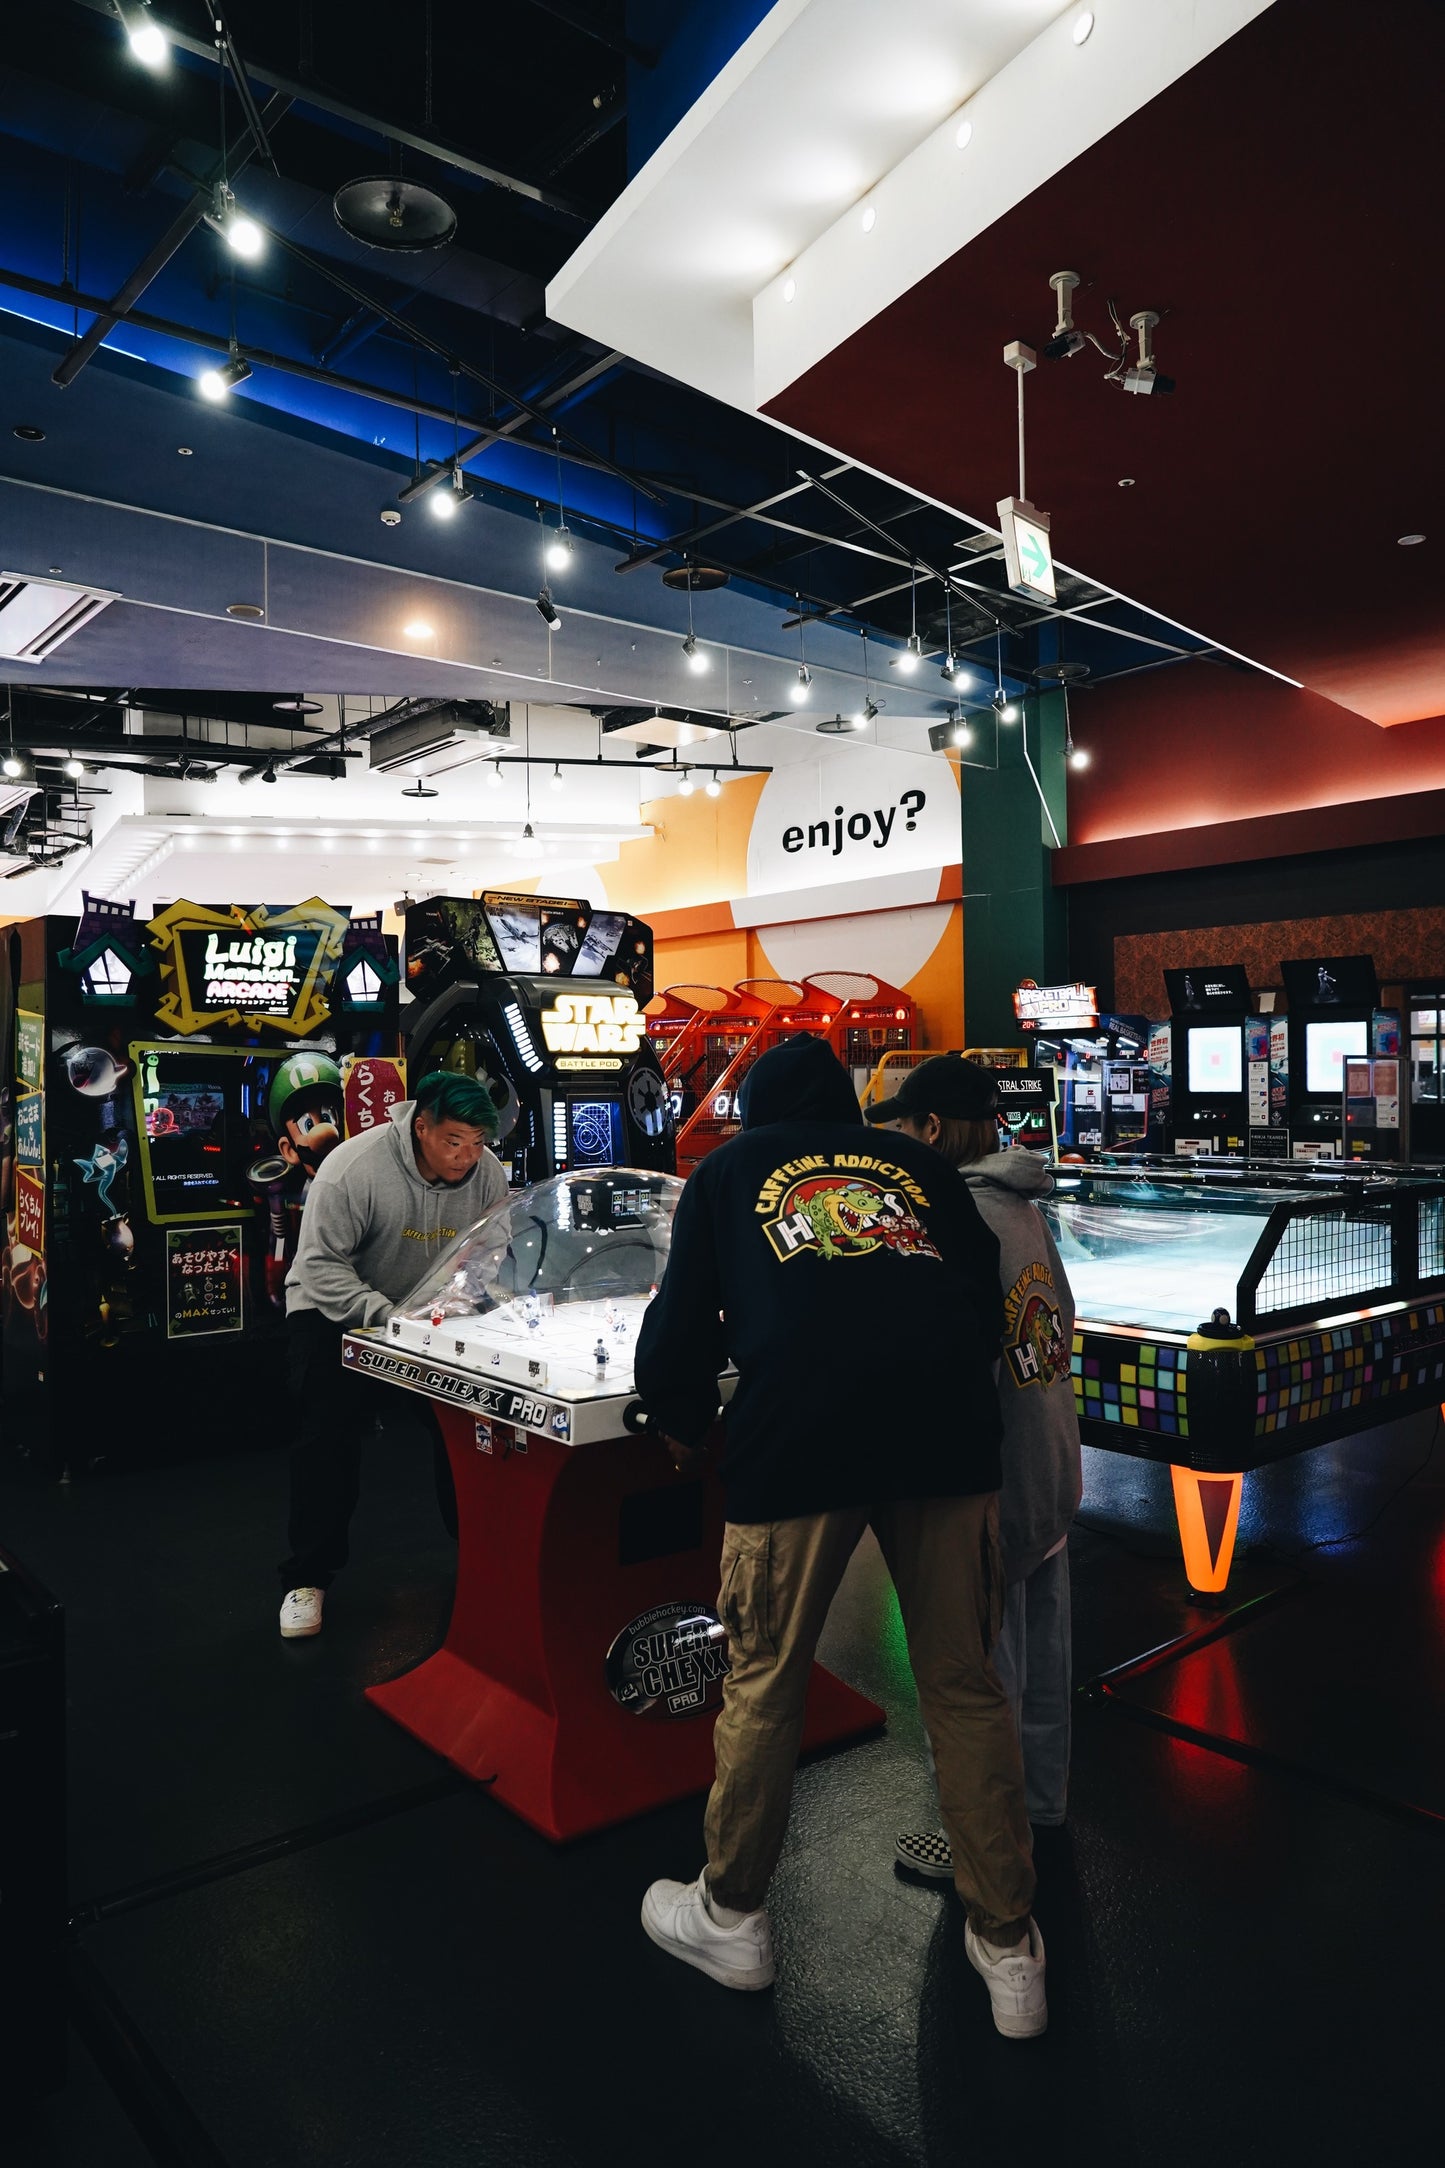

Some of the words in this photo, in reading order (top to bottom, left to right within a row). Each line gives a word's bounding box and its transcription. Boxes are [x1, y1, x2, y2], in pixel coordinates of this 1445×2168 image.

[782, 789, 927, 856] enjoy?
[205, 933, 297, 967] Luigi
[203, 963, 294, 982] Mansion
[206, 981, 288, 1000] ARCADE
[1018, 984, 1089, 1006] BASKETBALL
[541, 995, 646, 1024] STAR
[541, 1023, 646, 1053] WARS
[997, 1080, 1019, 1090] STRAL
[1020, 1080, 1042, 1090] STRIKE
[19, 1188, 41, 1218] らくちん
[171, 1248, 238, 1264] あそびやすく
[181, 1261, 230, 1275] なったよ!
[358, 1350, 421, 1381] SUPER
[425, 1371, 505, 1411] CHEXX
[509, 1396, 547, 1426] PRO
[552, 1412, 568, 1429] ICE
[628, 1605, 706, 1635] bubblehockey.com
[632, 1620, 711, 1669] SUPER
[642, 1645, 730, 1697] CHEXX
[672, 1692, 699, 1709] PRO
